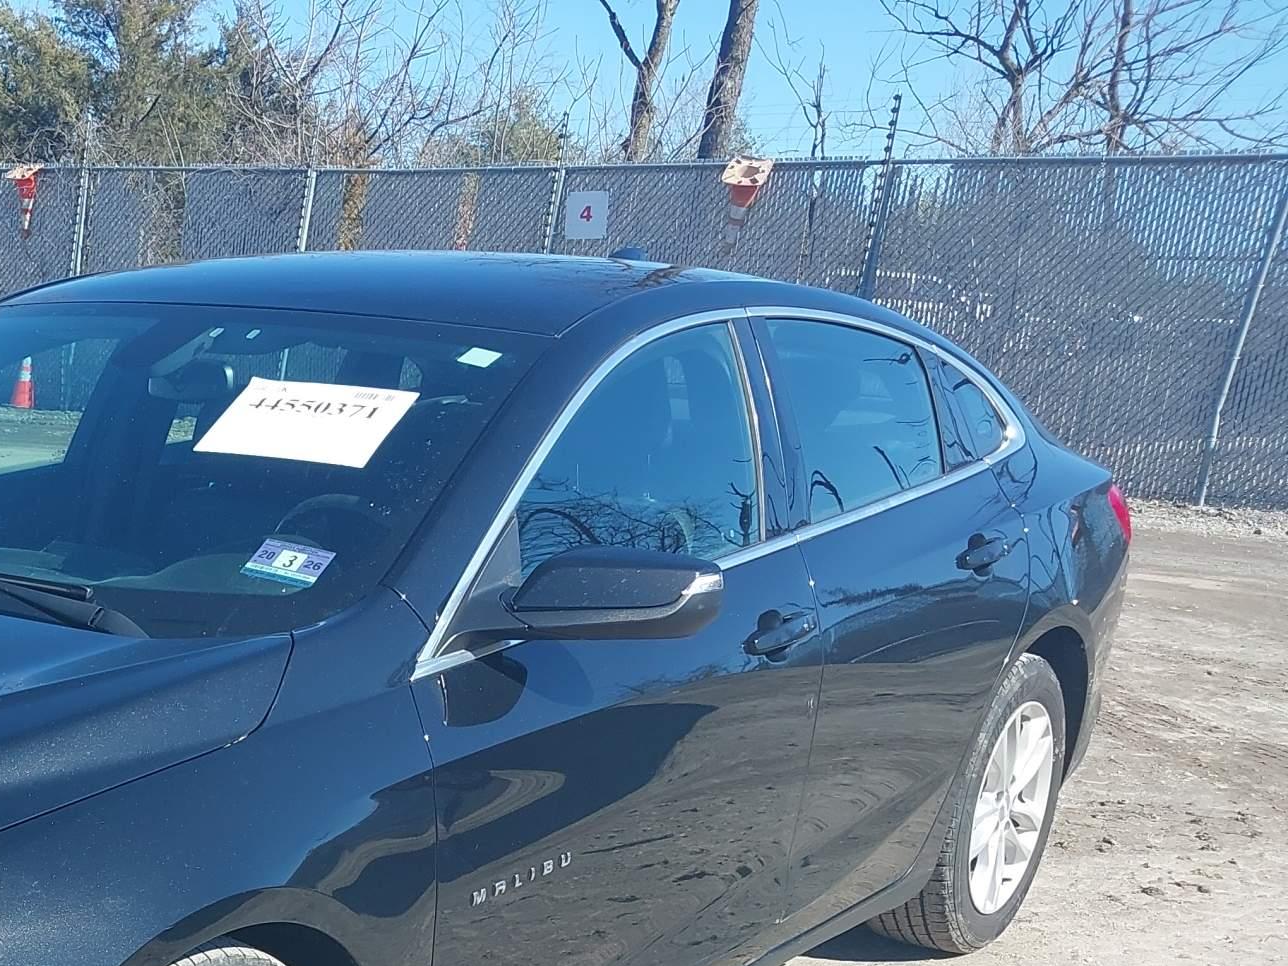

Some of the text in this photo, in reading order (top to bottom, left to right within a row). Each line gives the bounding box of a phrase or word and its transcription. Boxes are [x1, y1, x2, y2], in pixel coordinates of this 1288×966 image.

[580, 205, 593, 222] 4
[249, 397, 381, 420] 44550371
[258, 549, 276, 560] 20
[282, 555, 298, 568] 3
[303, 560, 323, 571] 26
[471, 851, 572, 907] MALIBU
